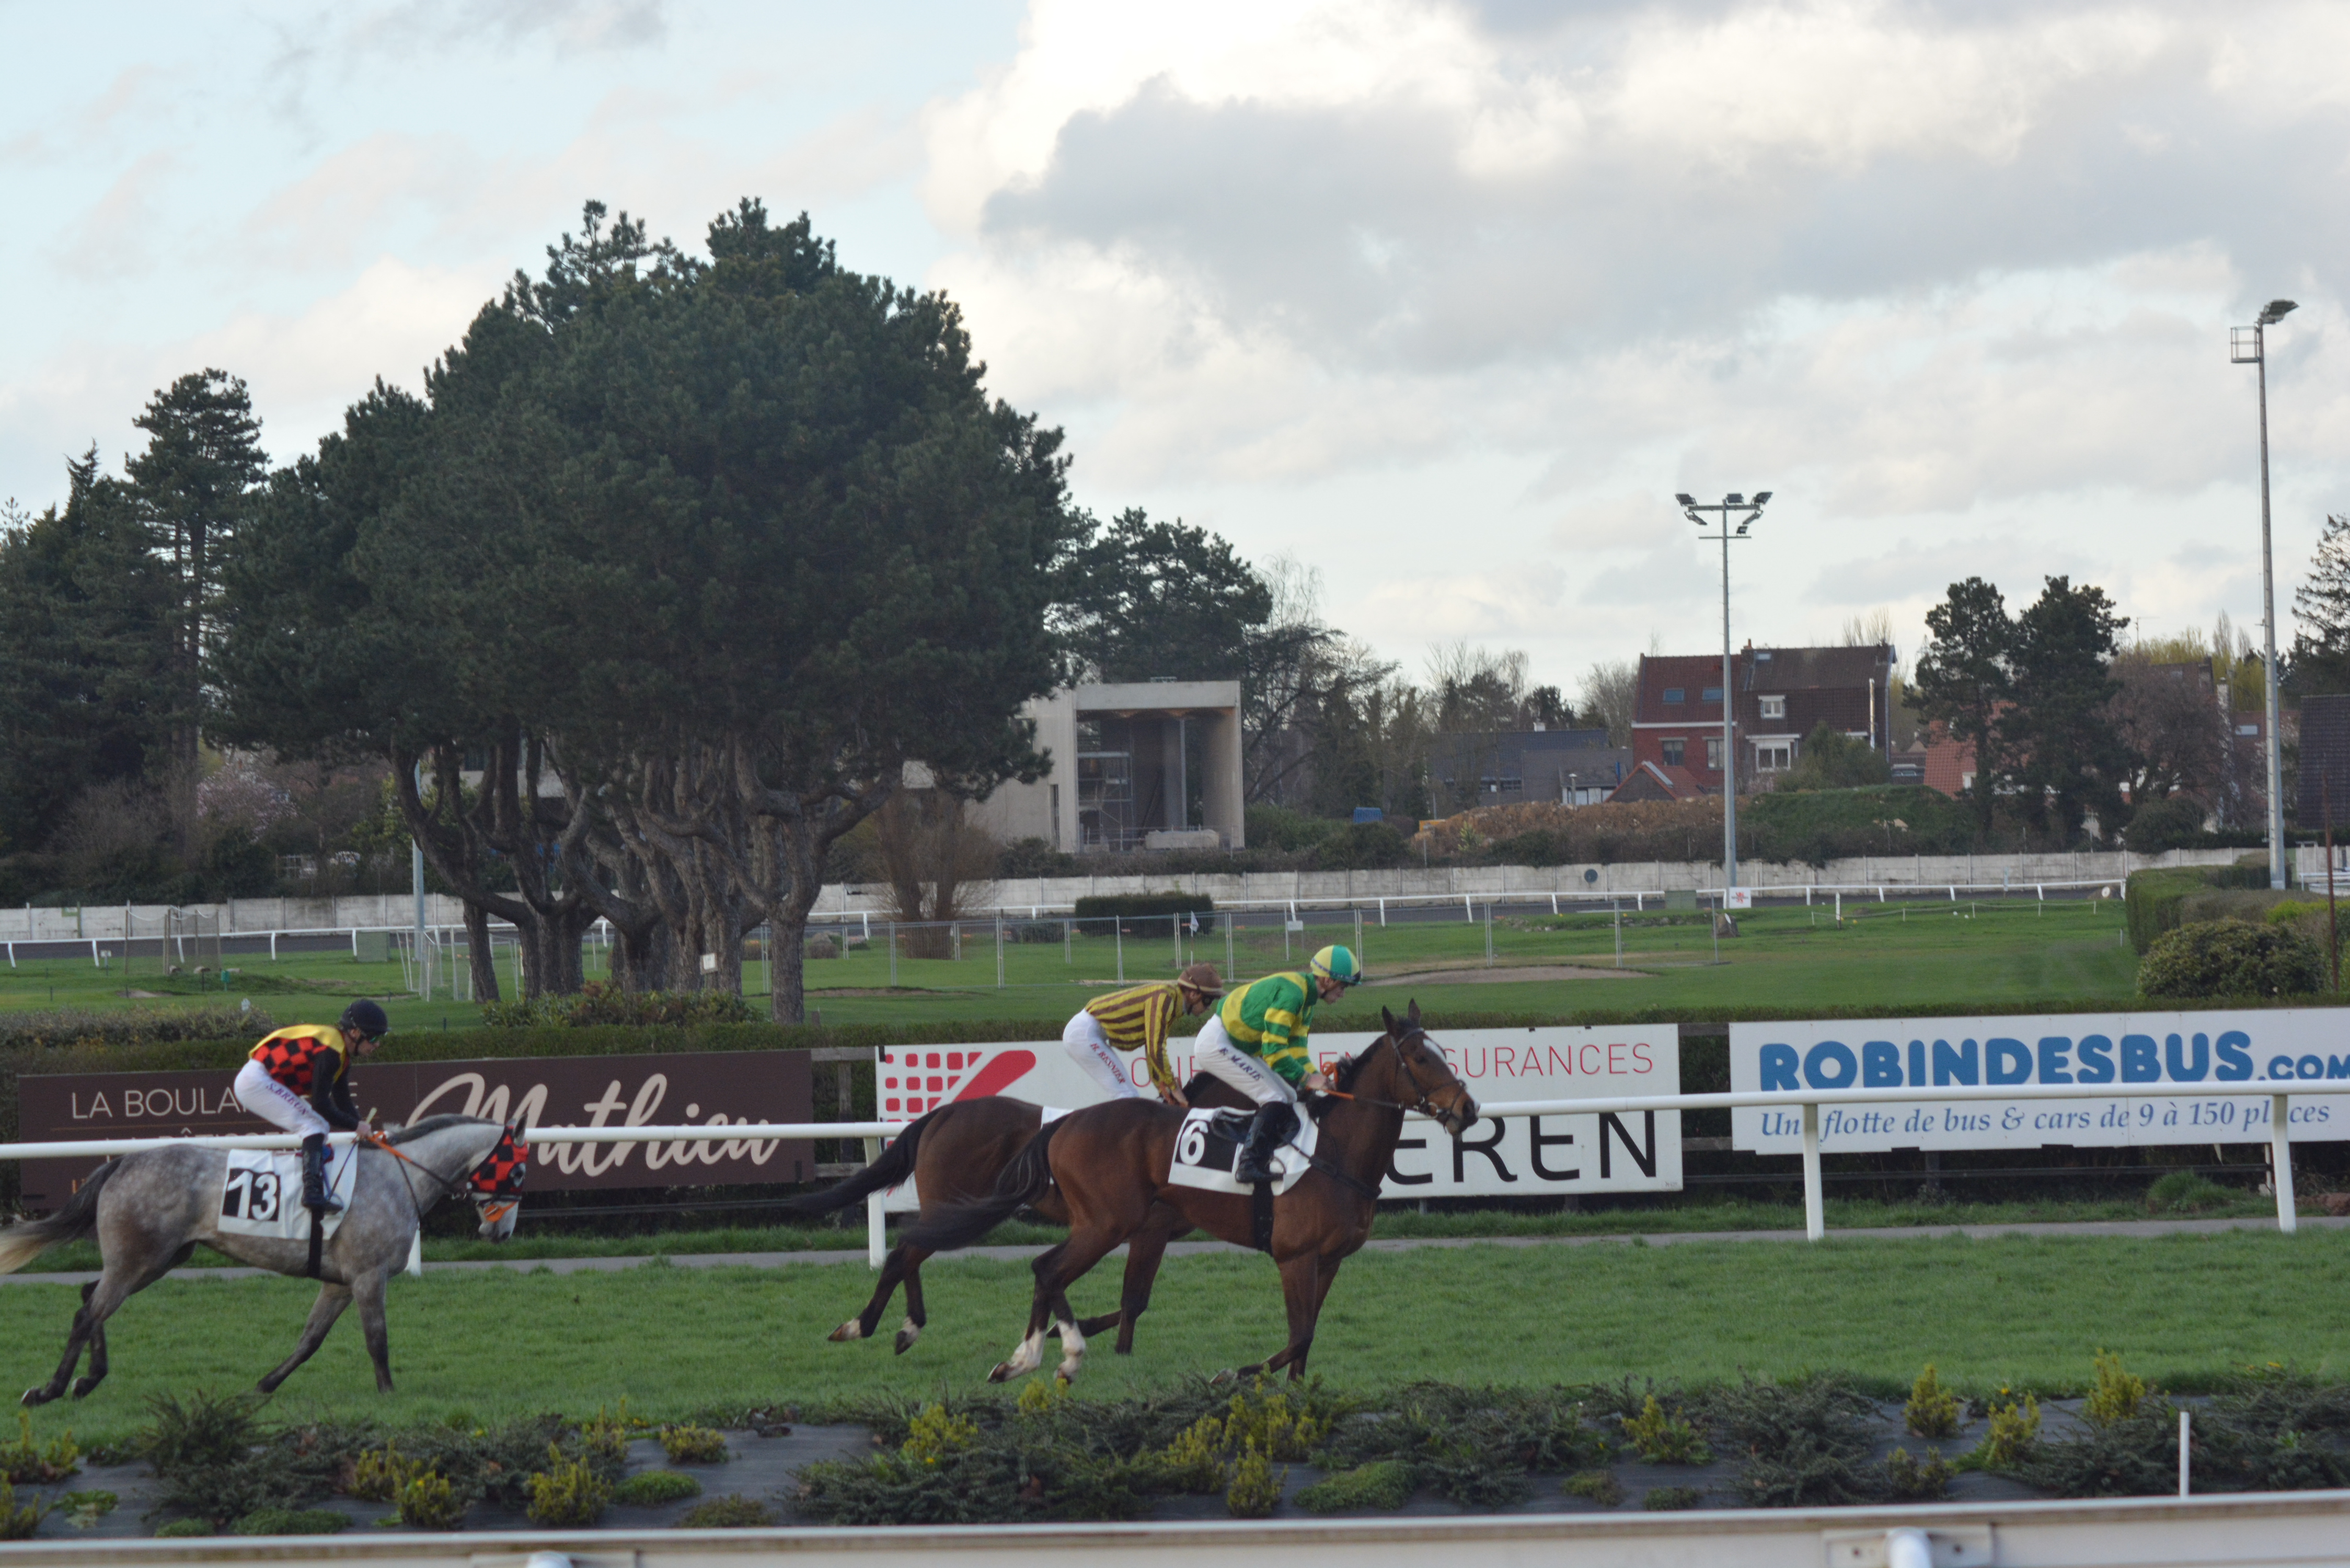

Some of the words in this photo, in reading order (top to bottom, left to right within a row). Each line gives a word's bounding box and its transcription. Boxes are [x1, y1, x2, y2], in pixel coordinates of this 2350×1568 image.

[1444, 1043, 1653, 1078] SURANCES
[72, 1092, 113, 1120] LA
[1761, 1112, 1801, 1136] Un
[1818, 1109, 1896, 1144] flotte
[1904, 1108, 1934, 1133] de
[1944, 1108, 1991, 1132] bus
[2000, 1106, 2025, 1131] &
[2034, 1110, 2090, 1129] cars
[2100, 1104, 2130, 1128] de
[2138, 1103, 2155, 1127] 9
[2162, 1101, 2179, 1126] à
[2188, 1101, 2235, 1125] 150
[2242, 1099, 2330, 1132] plces
[1180, 1120, 1208, 1166] 6
[227, 1170, 278, 1221] 13
